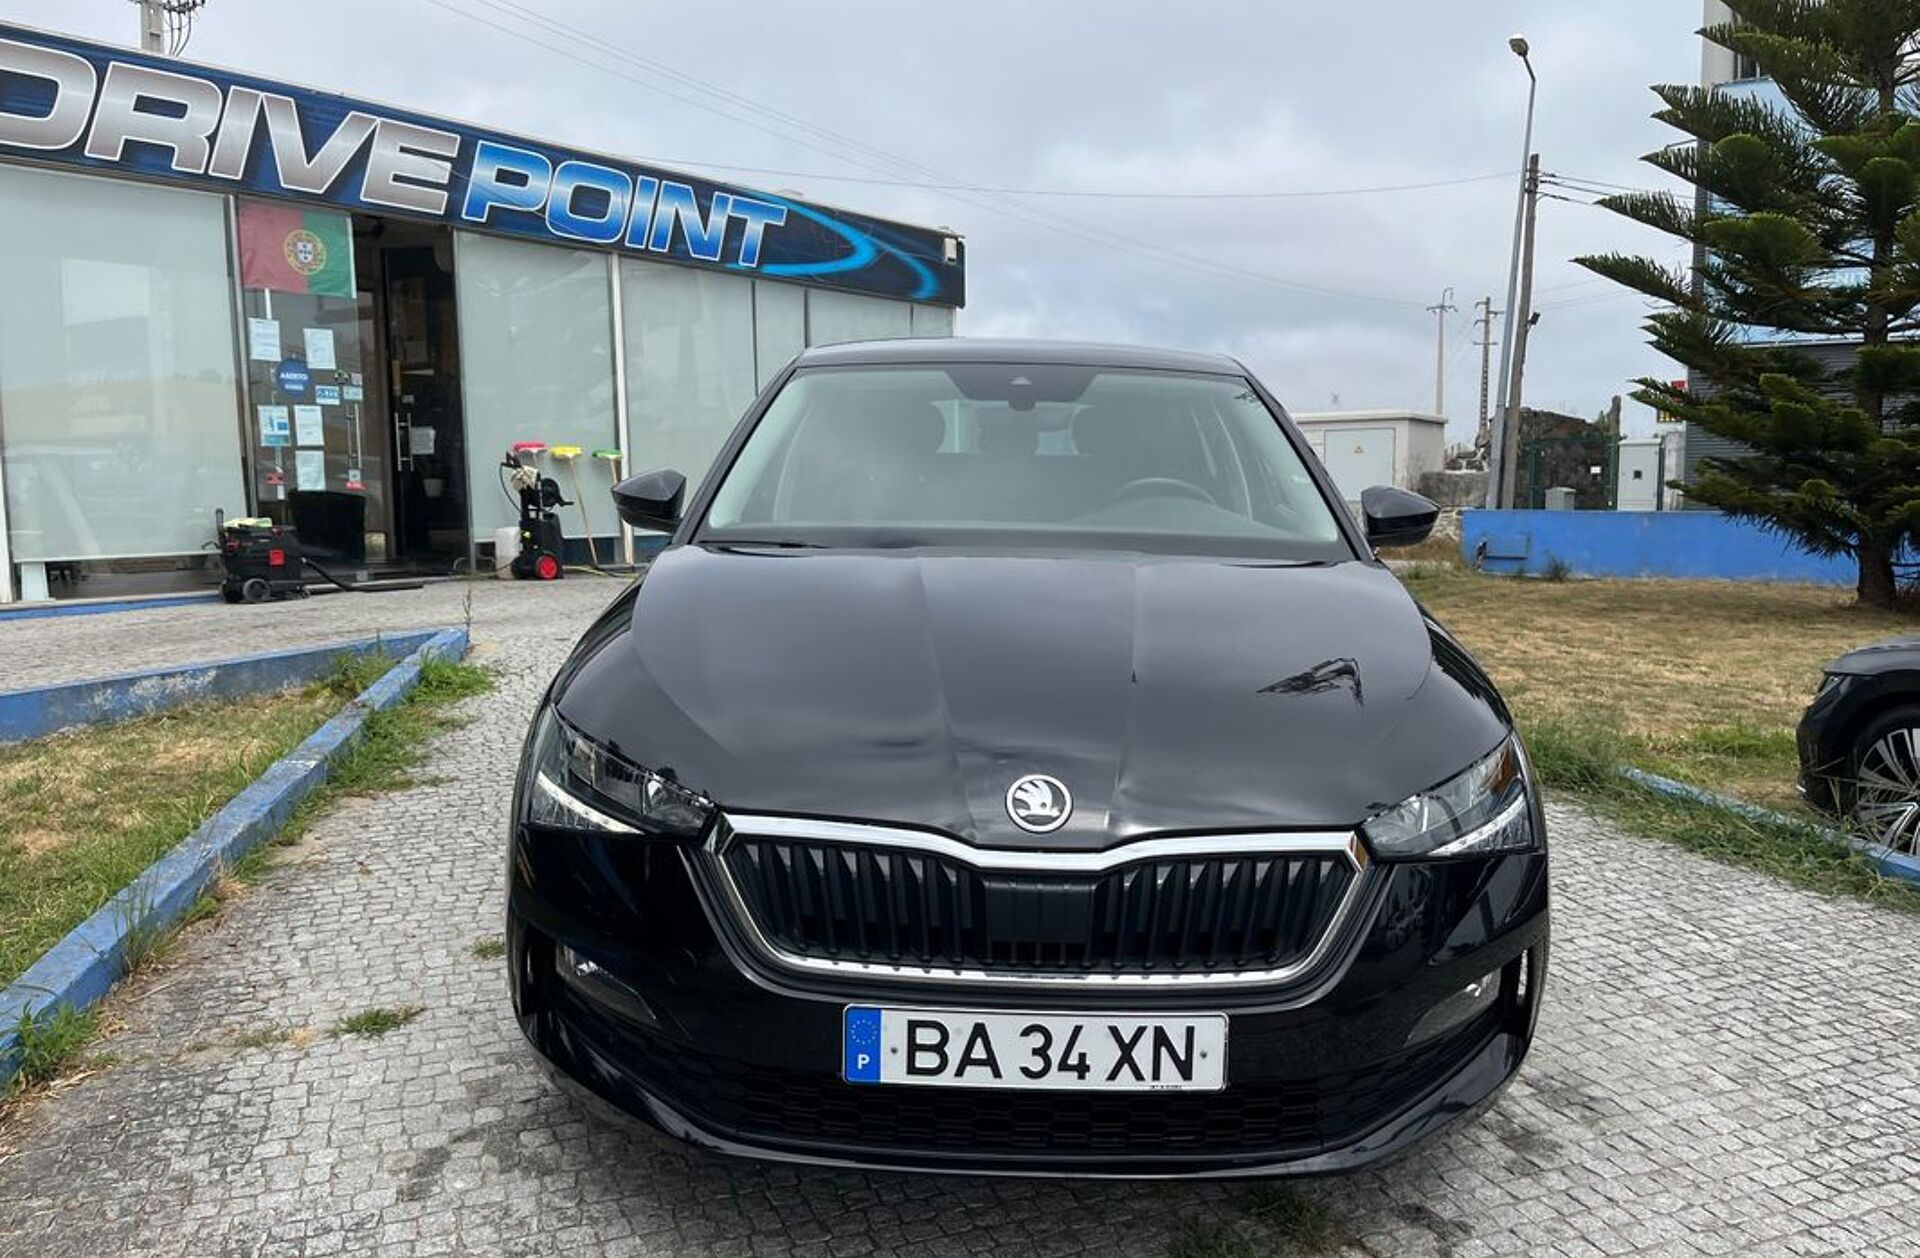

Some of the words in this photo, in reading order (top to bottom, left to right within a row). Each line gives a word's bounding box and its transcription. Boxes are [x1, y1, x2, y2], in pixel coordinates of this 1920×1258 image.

[0, 39, 461, 213] DRIVE
[461, 139, 788, 267] POINT
[857, 1053, 871, 1070] P
[906, 1019, 1003, 1079] BA
[1019, 1023, 1091, 1081] 34
[1105, 1025, 1195, 1082] XN
